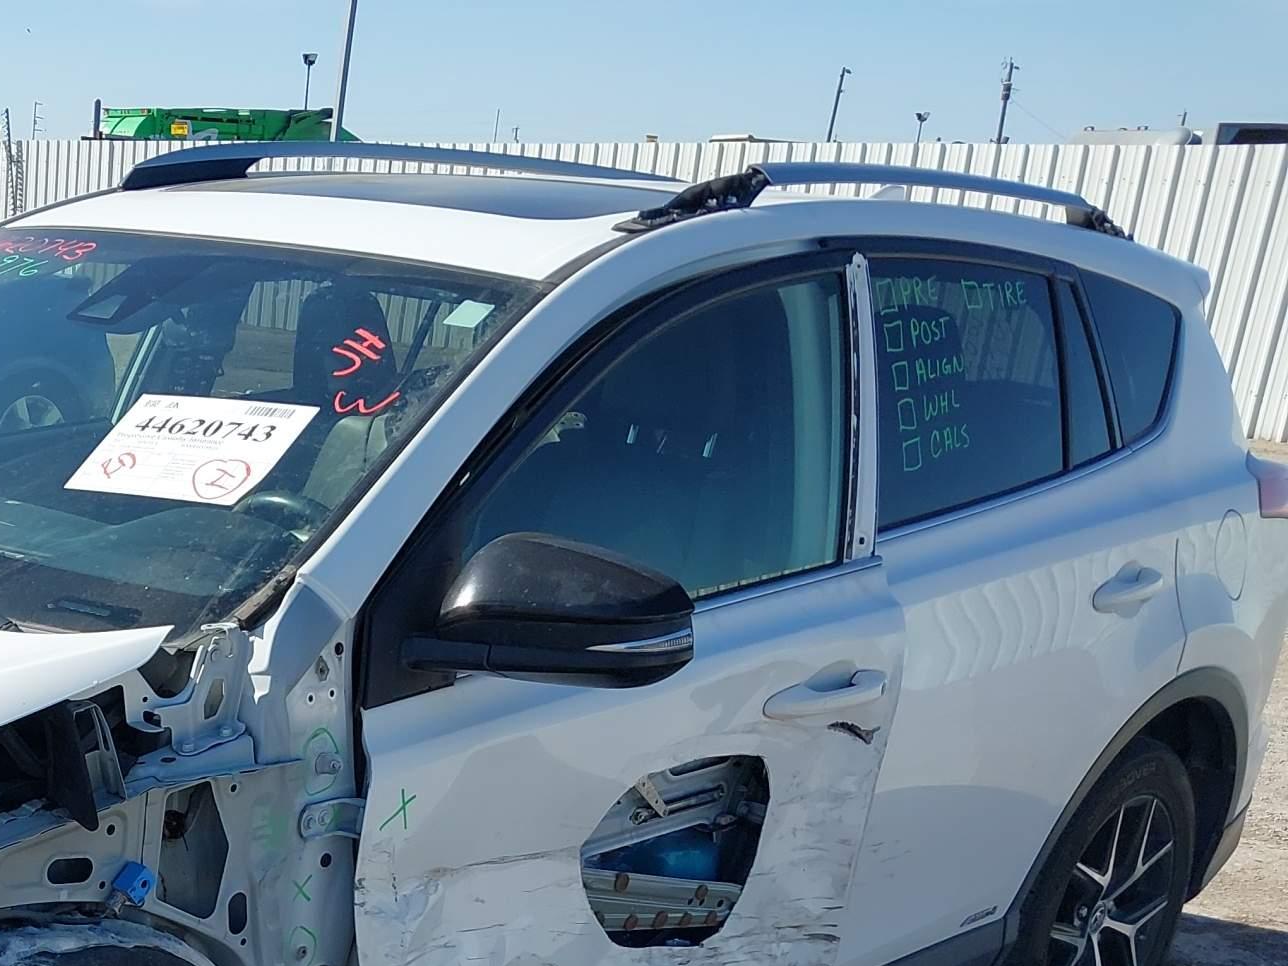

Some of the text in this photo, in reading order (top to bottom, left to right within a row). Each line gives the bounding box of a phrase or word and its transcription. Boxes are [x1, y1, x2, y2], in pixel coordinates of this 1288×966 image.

[899, 275, 938, 310] PRE
[983, 281, 1027, 311] TIRE
[910, 316, 950, 348] POST
[915, 353, 964, 385] ALIGN
[923, 389, 960, 421] WHL
[135, 415, 277, 443] 44620743
[930, 423, 970, 458] CALS
